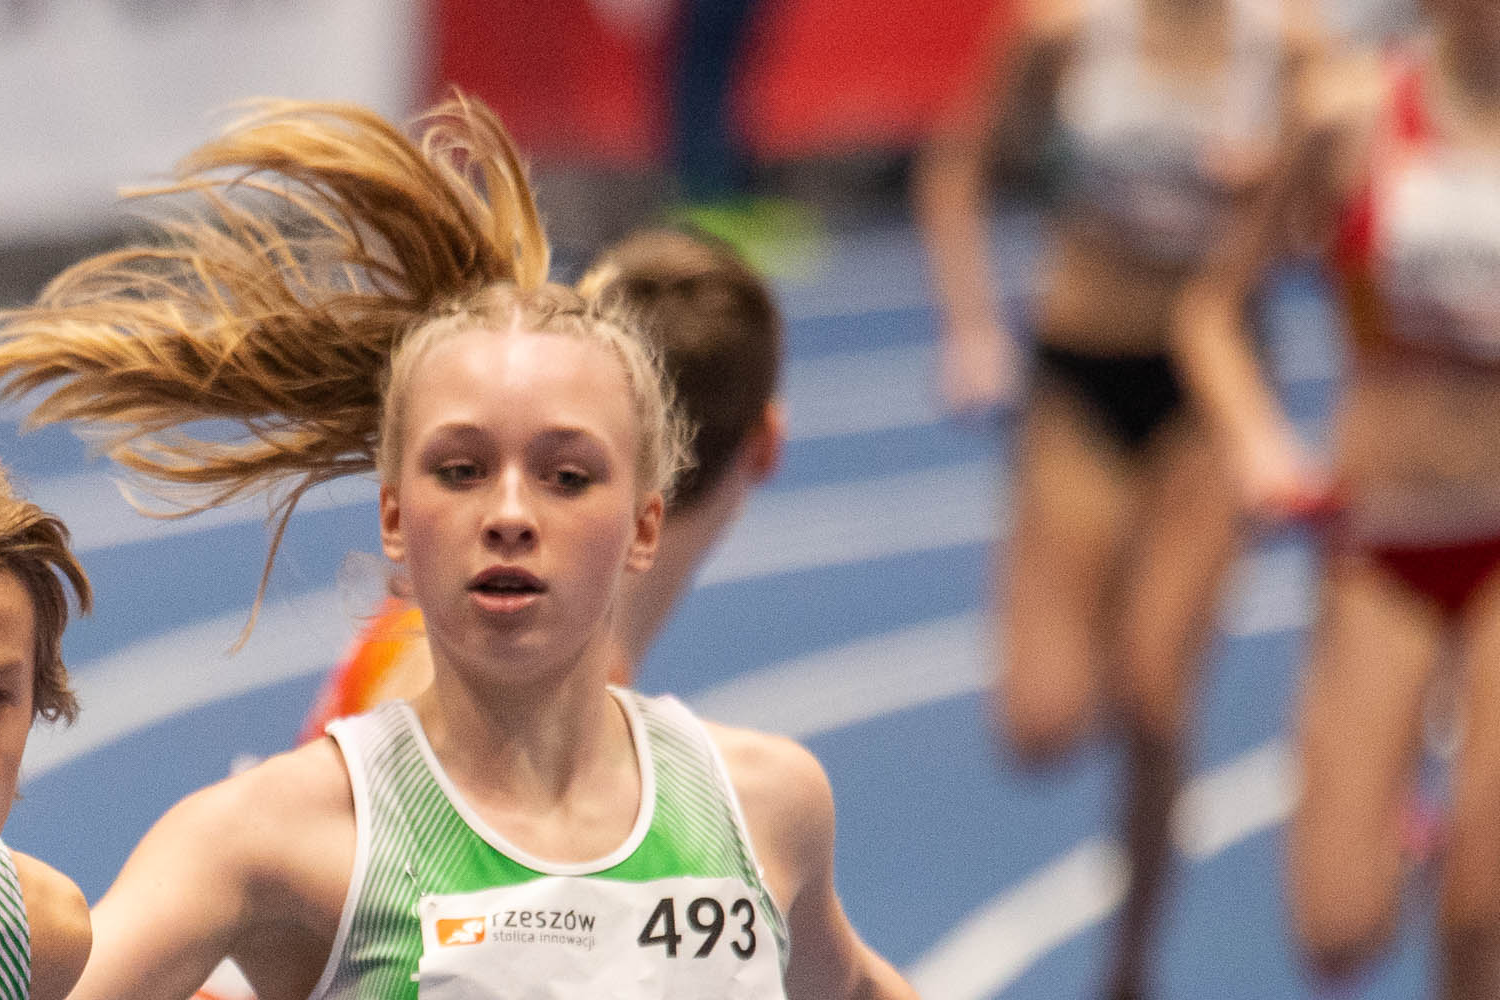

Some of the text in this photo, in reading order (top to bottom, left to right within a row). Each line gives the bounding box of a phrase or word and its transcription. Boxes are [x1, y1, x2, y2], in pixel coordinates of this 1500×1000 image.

[492, 909, 596, 933] rzeszów
[636, 896, 757, 961] 493
[492, 930, 596, 952] stolica innowacji
